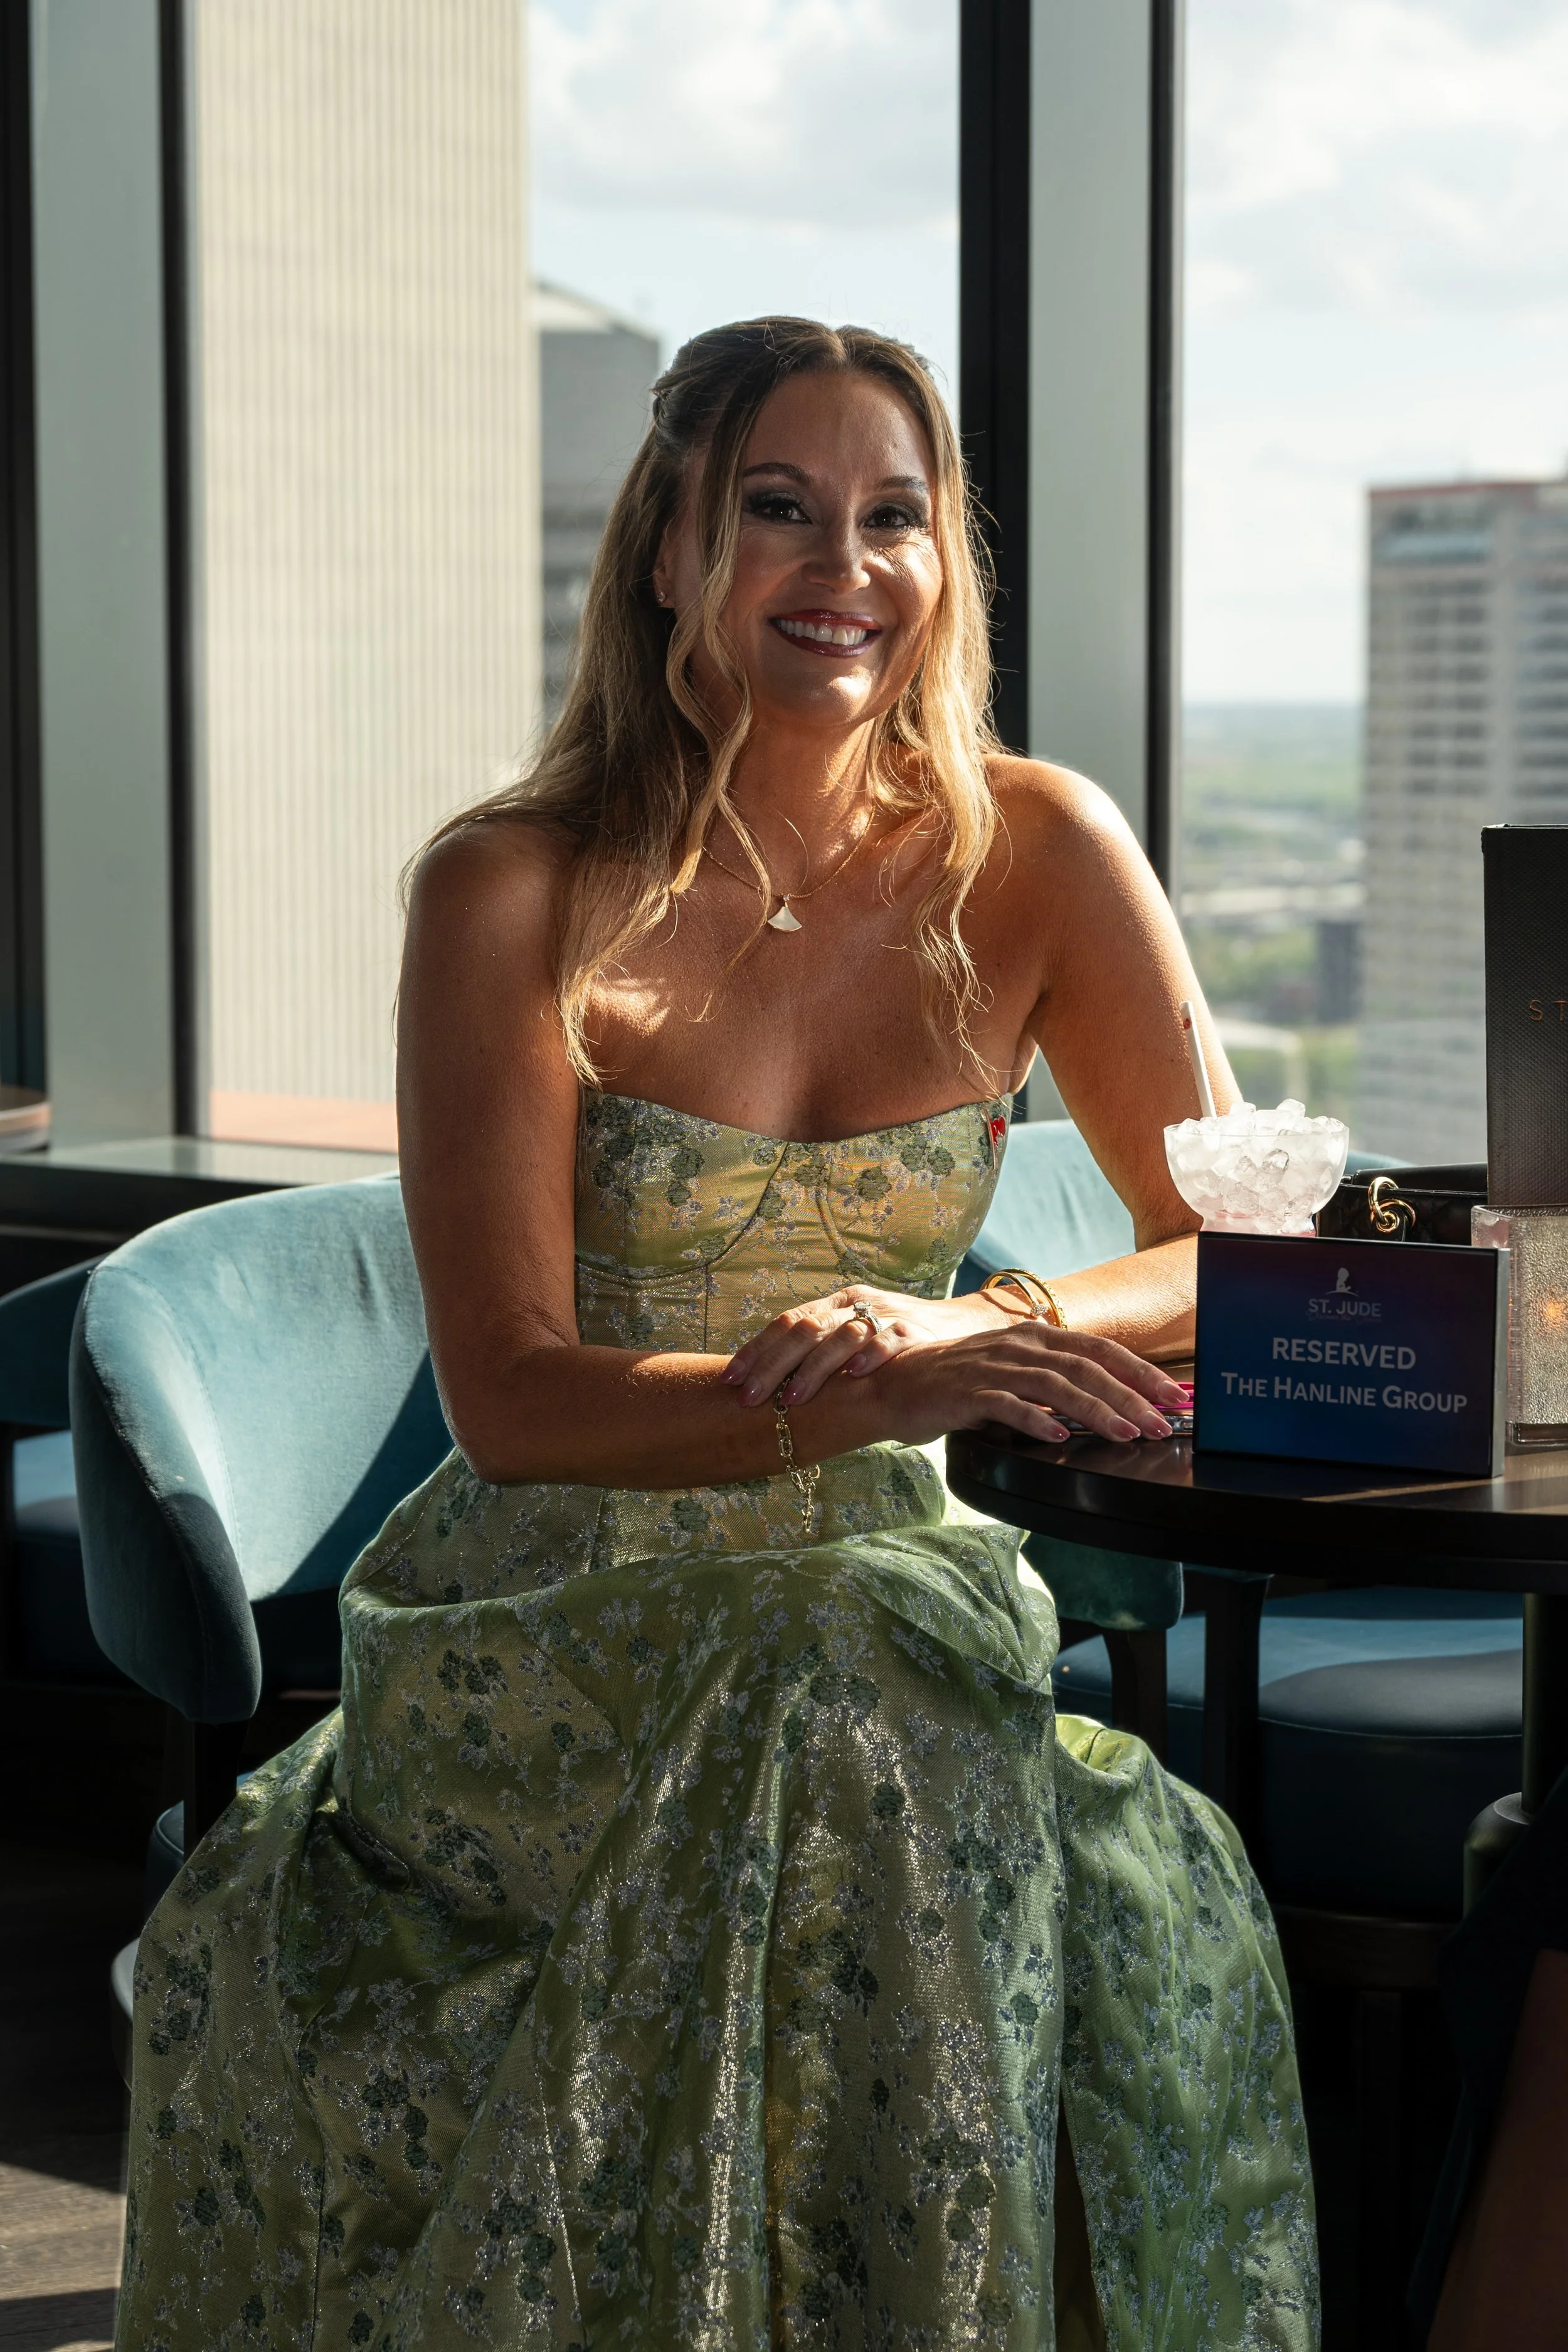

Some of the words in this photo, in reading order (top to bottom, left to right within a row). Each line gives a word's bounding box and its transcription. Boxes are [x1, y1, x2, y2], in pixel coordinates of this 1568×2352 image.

[1308, 1298, 1332, 1314] ST.
[1336, 1300, 1382, 1317] JUDE
[1272, 1337, 1416, 1370] RESERVED
